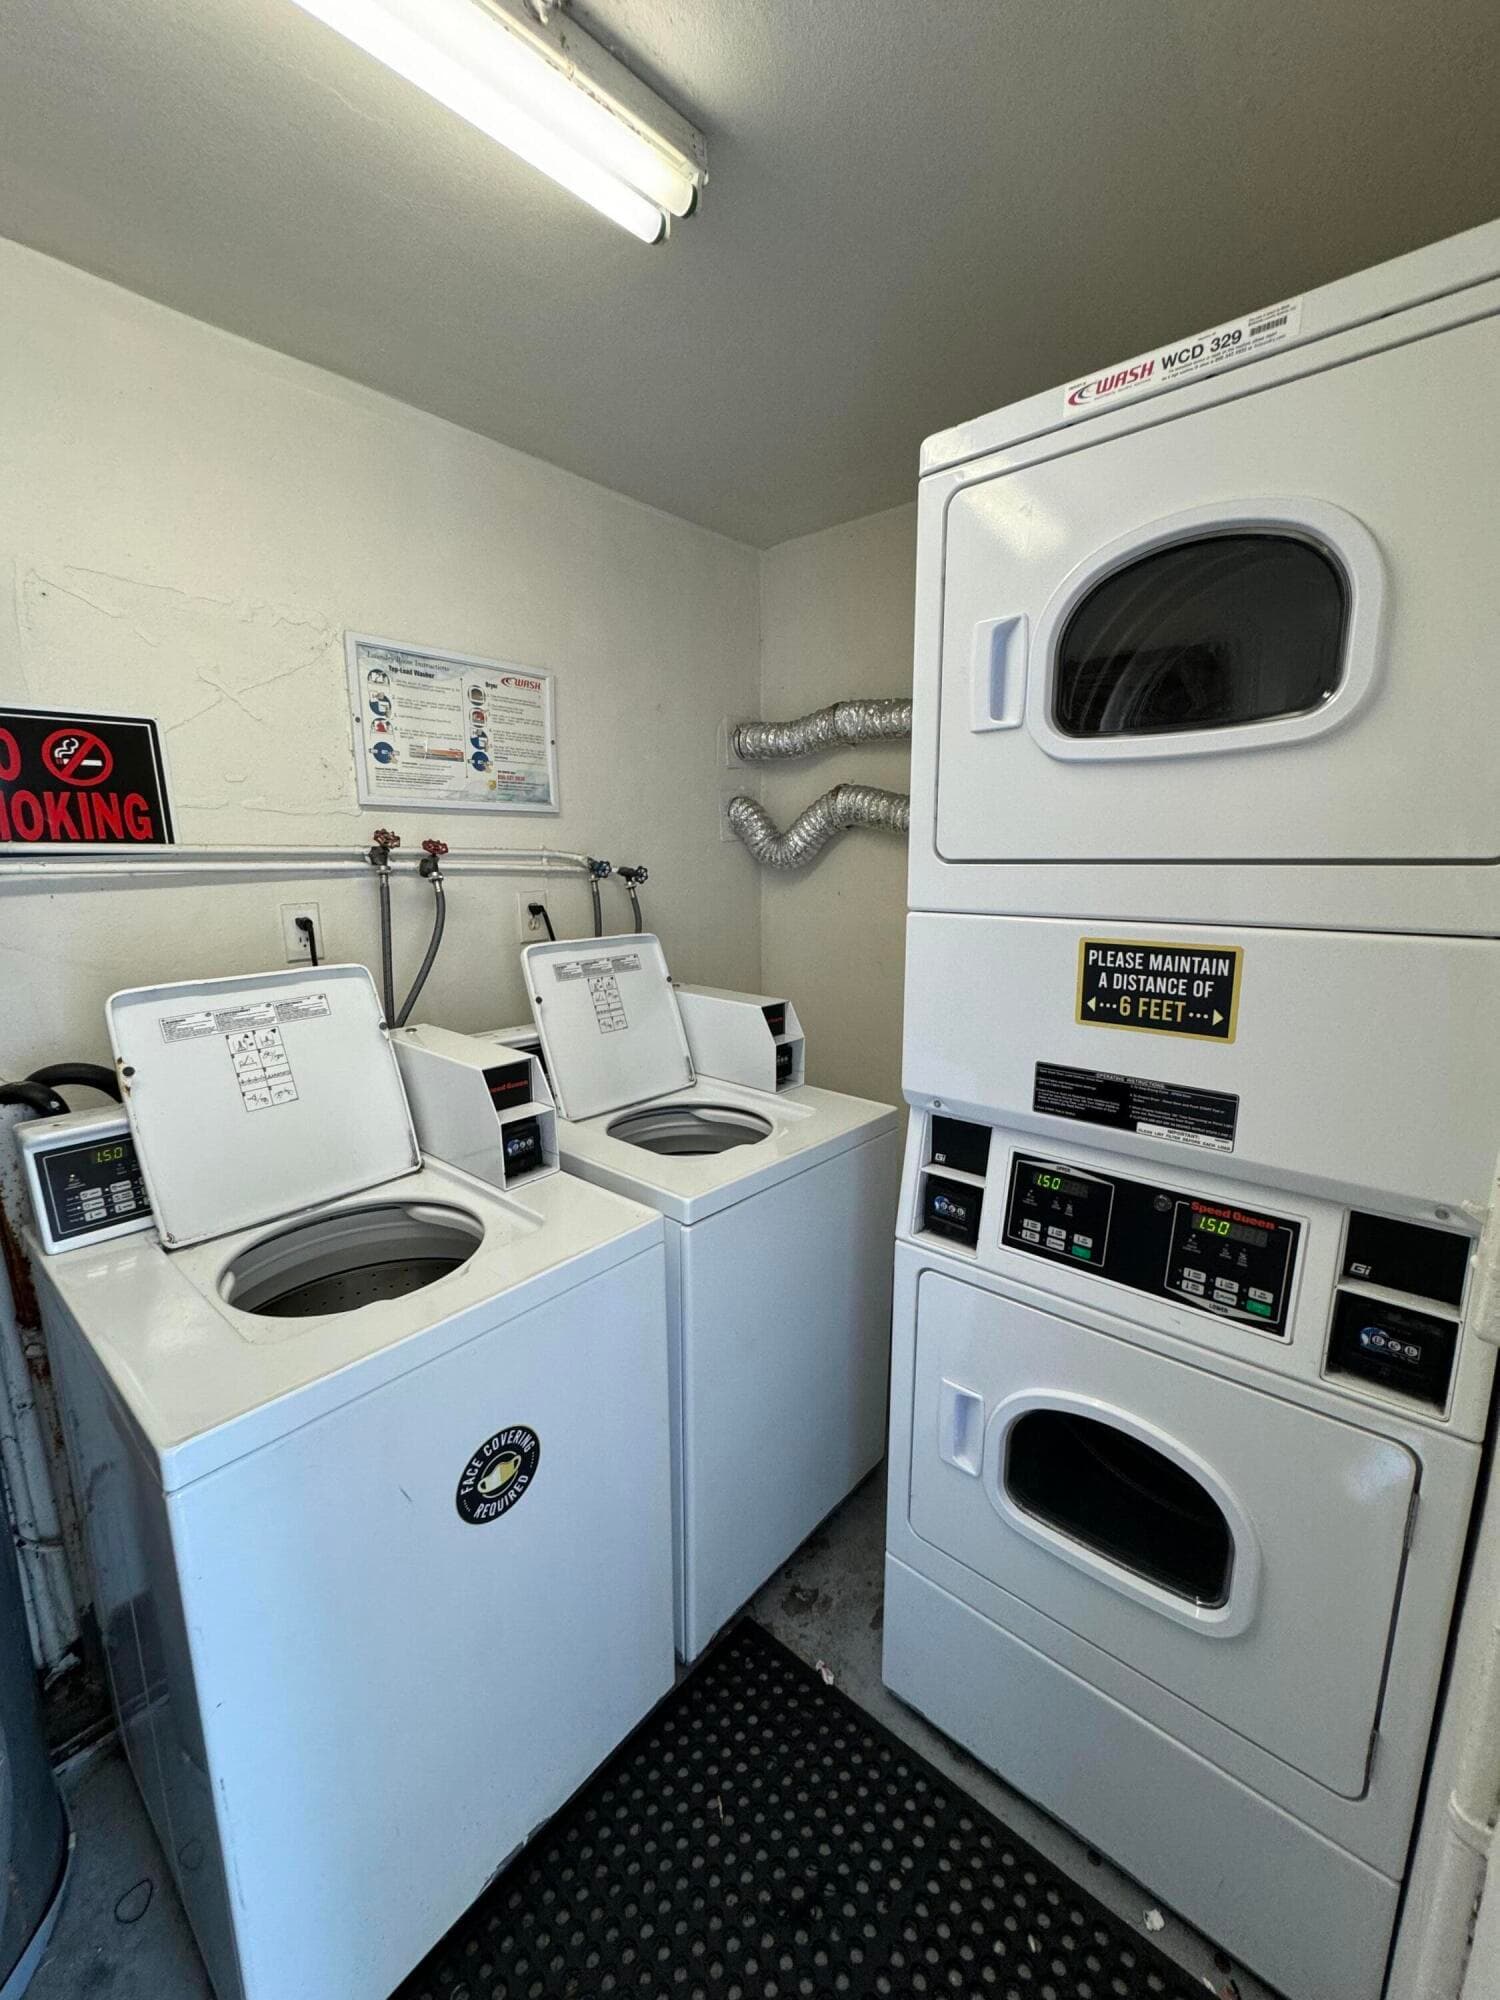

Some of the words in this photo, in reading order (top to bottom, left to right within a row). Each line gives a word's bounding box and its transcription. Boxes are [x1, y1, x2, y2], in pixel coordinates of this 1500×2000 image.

[1095, 359, 1155, 395] WASH
[1161, 344, 1205, 370] WCD
[1210, 329, 1243, 353] 329
[514, 678, 542, 691] WASH
[0, 788, 154, 841] OKING
[1088, 949, 1144, 970] PLEASE
[1149, 953, 1230, 977] MAINTAIN
[1098, 971, 1108, 989] A
[1112, 973, 1188, 996] DISTANCE
[1192, 979, 1215, 998] OF
[1119, 995, 1131, 1017] 6
[1137, 996, 1187, 1023] FEET
[1191, 1201, 1231, 1219] Speed
[1232, 1211, 1276, 1231] Queen
[1208, 1302, 1229, 1314] LOWER
[461, 1458, 484, 1496] FACE
[483, 1429, 536, 1457] COVERING
[473, 1474, 529, 1519] REQUIRED
